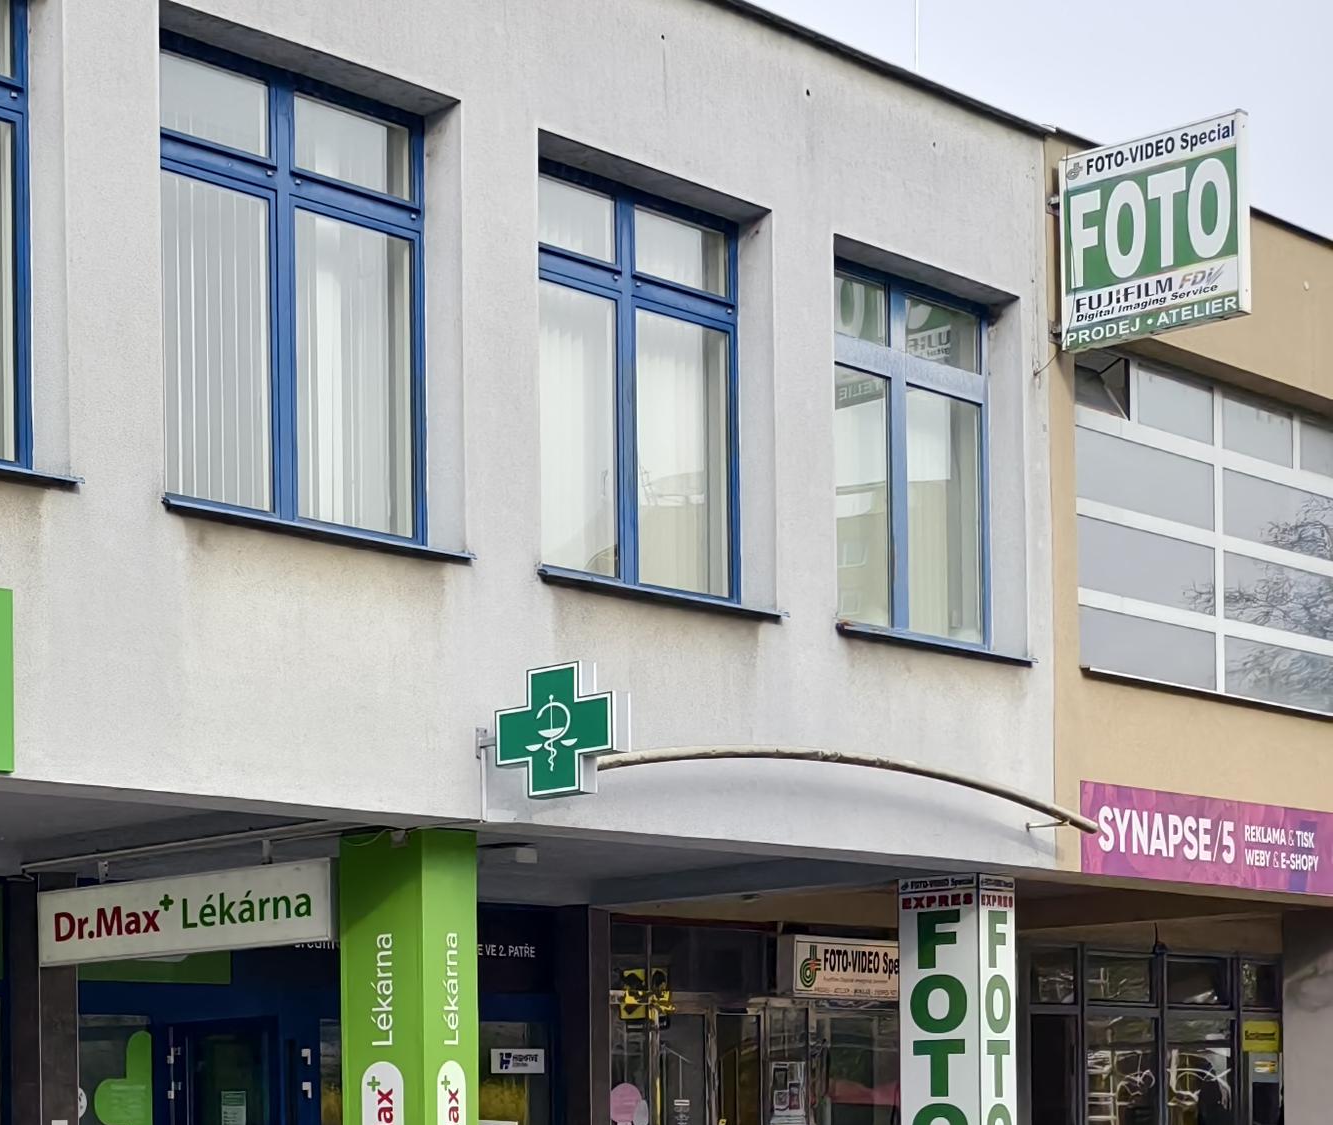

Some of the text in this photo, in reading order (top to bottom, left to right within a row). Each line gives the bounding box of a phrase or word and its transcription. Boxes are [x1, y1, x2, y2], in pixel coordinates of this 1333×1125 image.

[1086, 120, 1235, 176] FOTO-VIDEO Special
[1070, 157, 1231, 289] FOTO
[1075, 276, 1173, 313] FUJIFILM
[1076, 283, 1219, 323] Digital Imaging Service
[1066, 296, 1238, 347] PRODEJ ATELIER
[1244, 825, 1286, 846] REKLAMA
[1295, 830, 1315, 848] TISK
[1245, 848, 1270, 867] WEBY
[1280, 852, 1319, 873] E-SHOPY
[182, 890, 312, 929] Lékárna
[902, 893, 973, 910] EXPRES
[981, 894, 1013, 908] EXPRES
[485, 944, 497, 956] VE
[508, 943, 536, 958] PATŘE
[823, 948, 880, 974] FOTO-VIDEO
[371, 933, 393, 1046] Lékárna
[442, 932, 459, 1045] Lékárna
